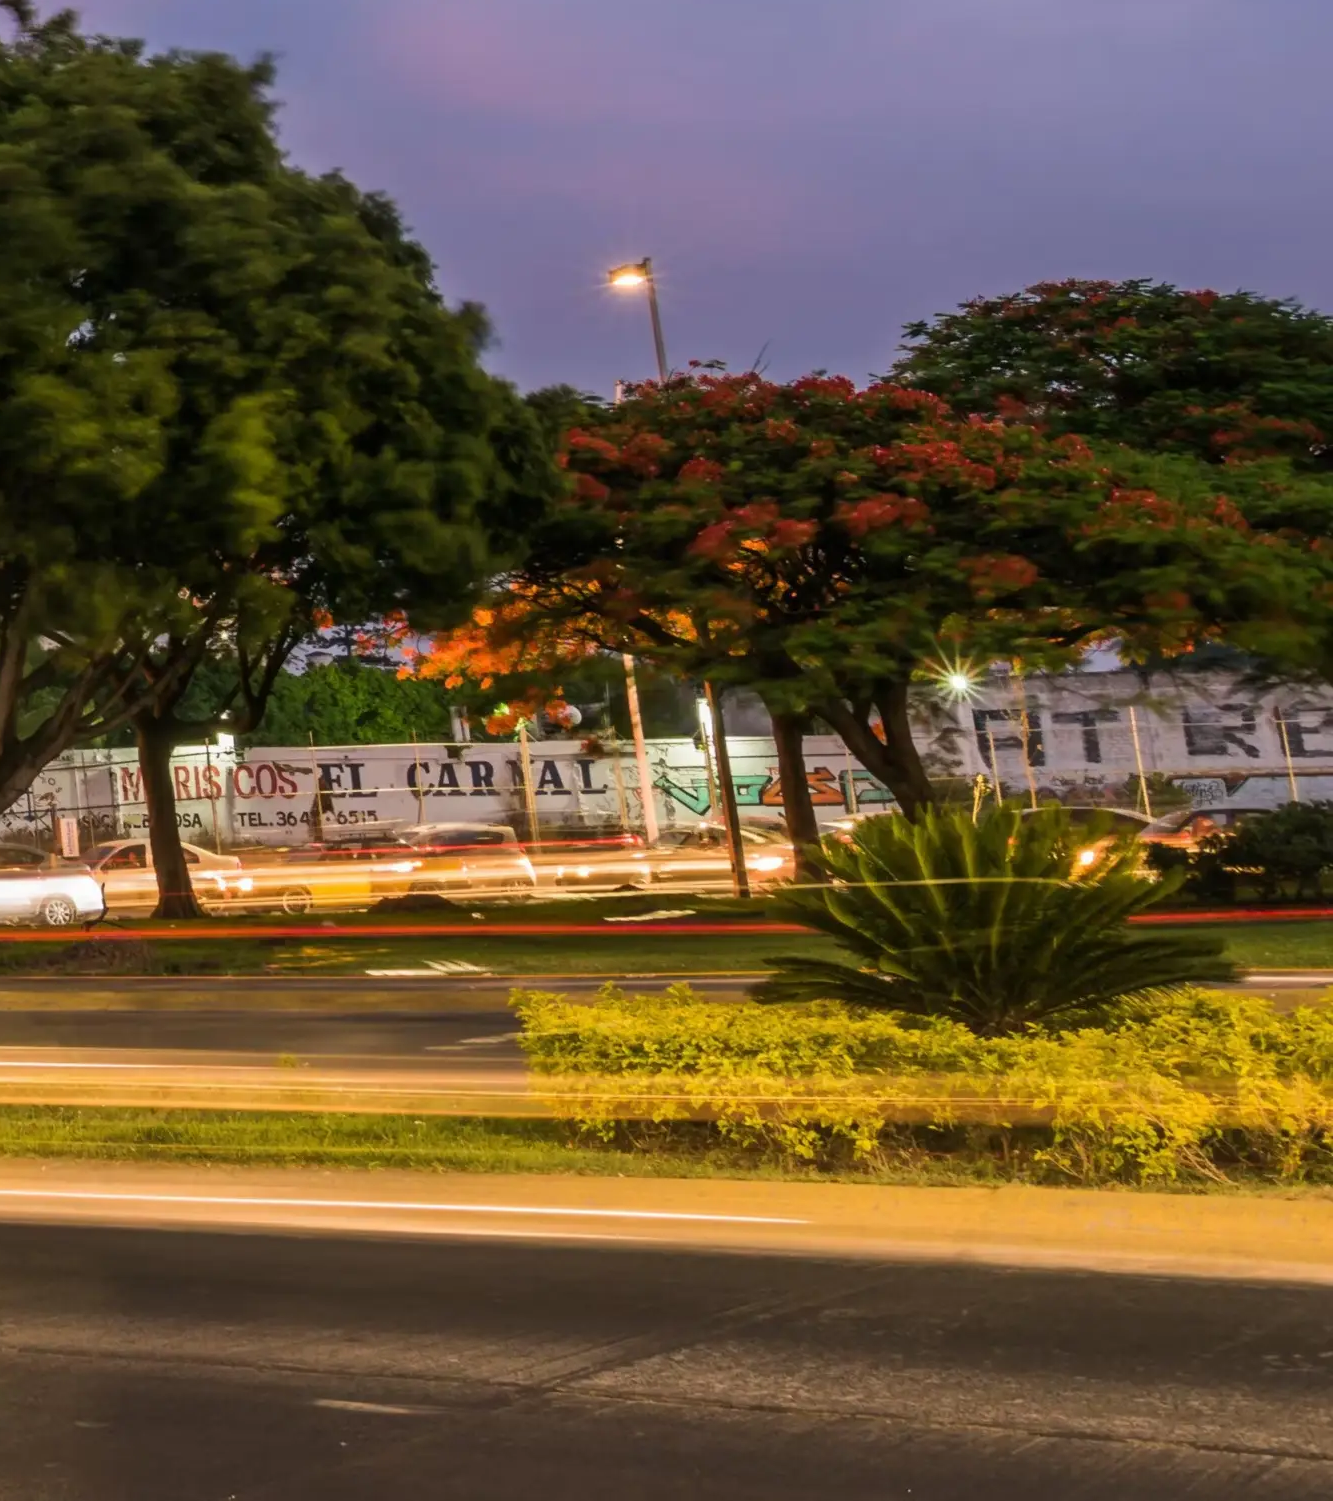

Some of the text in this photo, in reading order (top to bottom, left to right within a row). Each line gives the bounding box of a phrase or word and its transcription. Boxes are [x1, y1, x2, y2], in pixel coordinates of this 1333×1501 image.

[120, 764, 298, 801] MRISCOS
[316, 762, 379, 799] EL
[237, 812, 274, 827] TEL.
